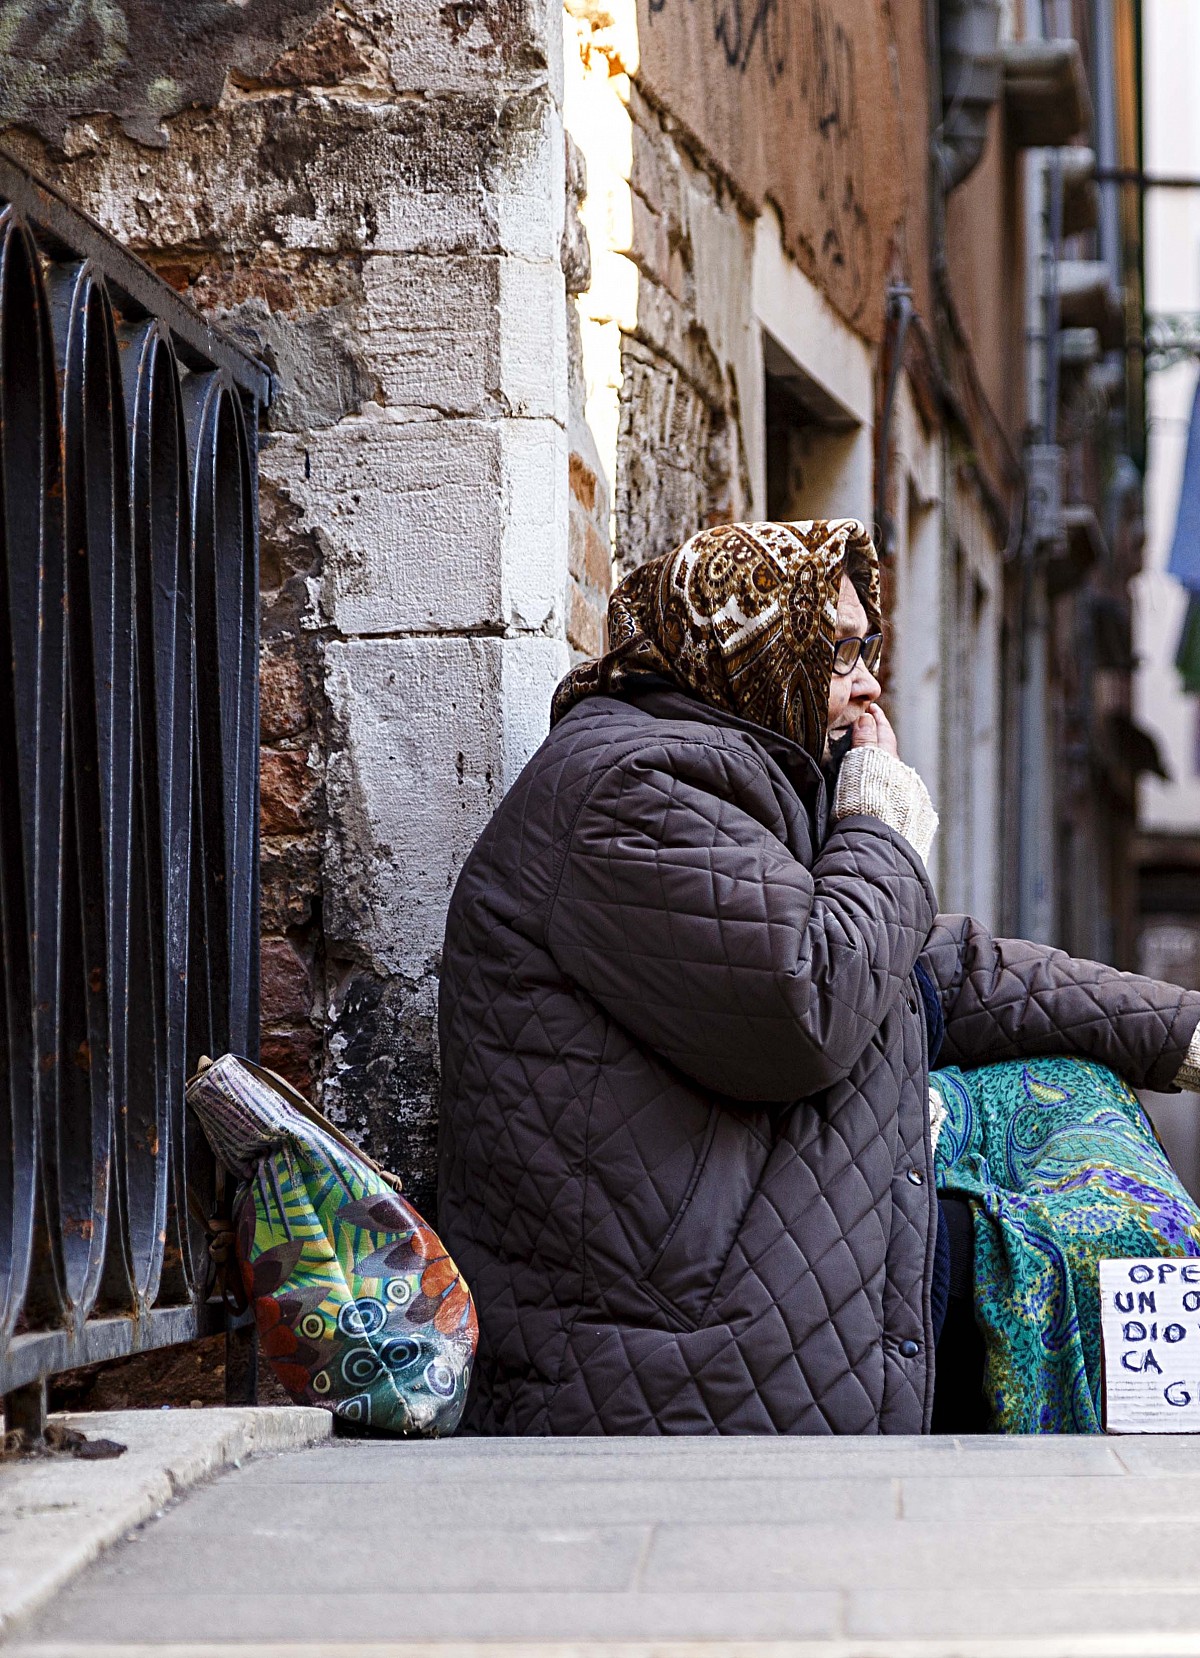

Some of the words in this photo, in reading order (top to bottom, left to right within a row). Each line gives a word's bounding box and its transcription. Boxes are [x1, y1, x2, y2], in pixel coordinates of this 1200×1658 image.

[1114, 1291, 1157, 1314] UN
[1122, 1321, 1187, 1343] DIO
[1120, 1349, 1163, 1374] CA
